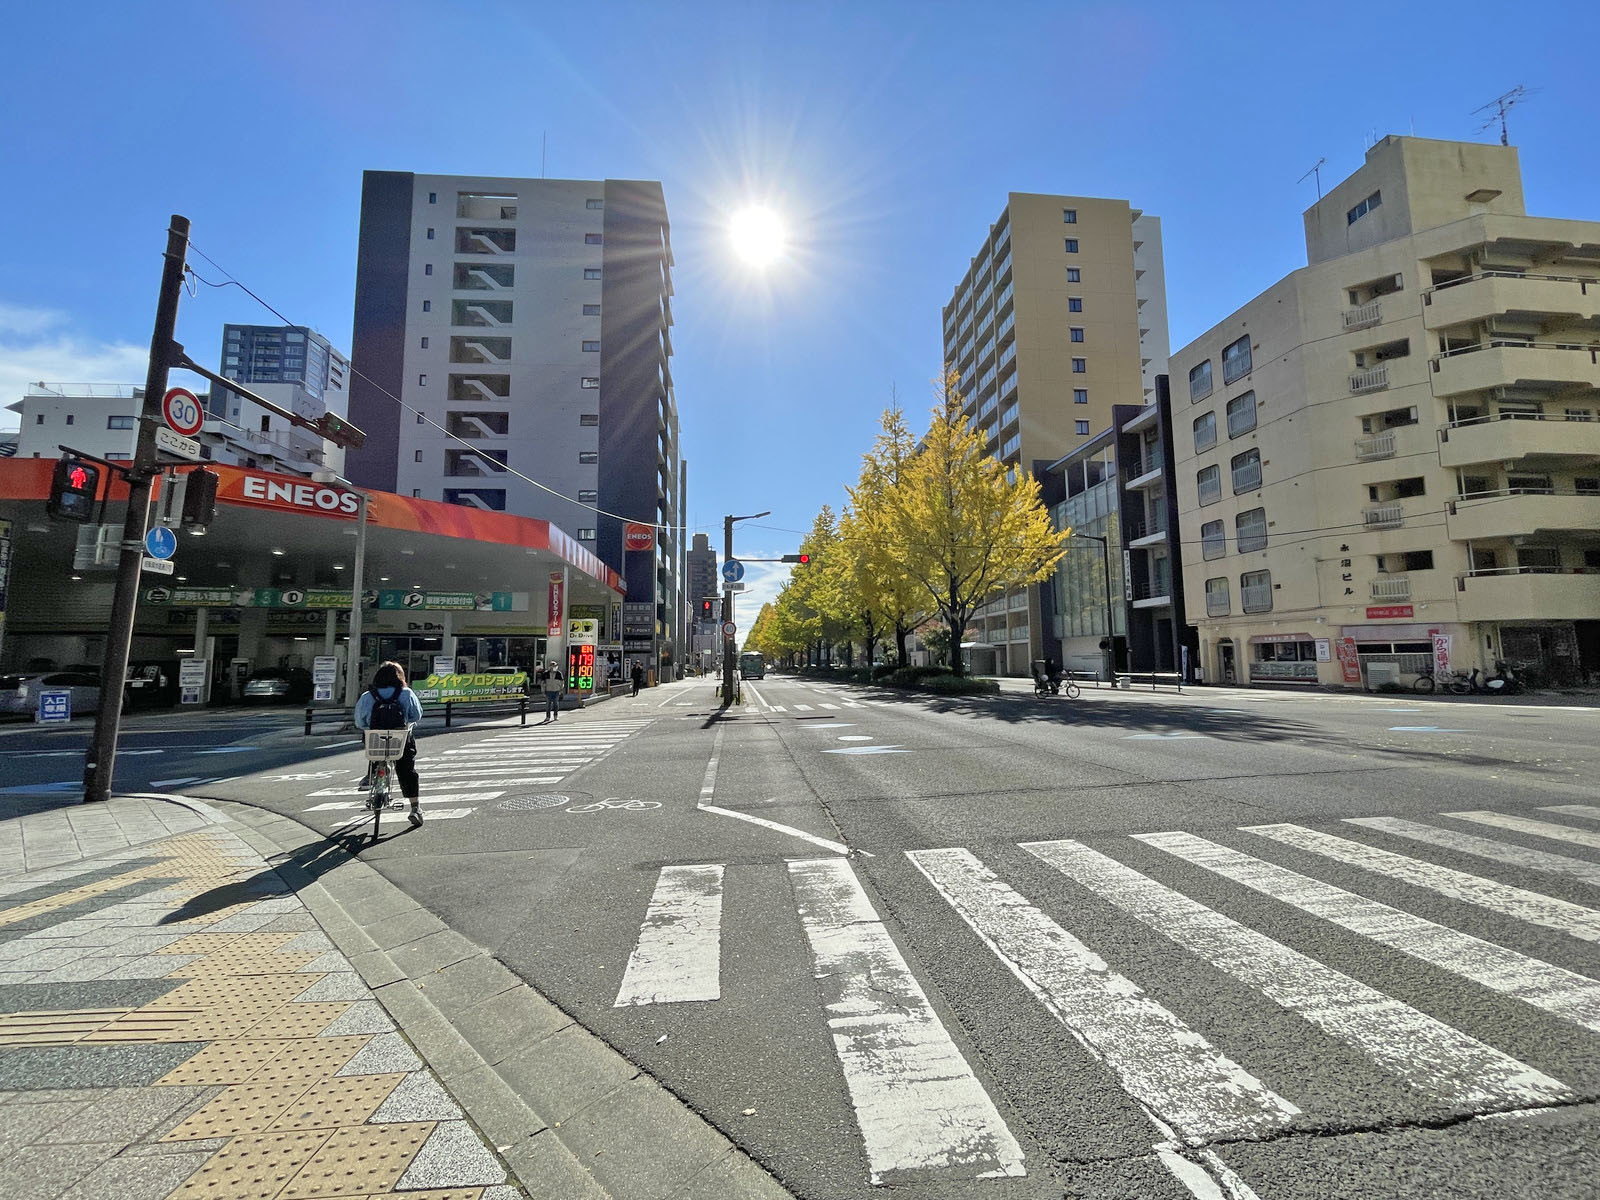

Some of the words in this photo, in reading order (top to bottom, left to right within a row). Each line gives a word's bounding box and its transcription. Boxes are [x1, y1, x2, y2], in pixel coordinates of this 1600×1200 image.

[173, 399, 196, 425] 30
[160, 432, 197, 455] ここから
[243, 476, 358, 513] ENEOS
[384, 593, 395, 606] 2
[578, 654, 593, 666] 179
[578, 665, 593, 677] 190
[426, 672, 527, 689] タイヤプロショップ
[44, 697, 66, 705] 入口
